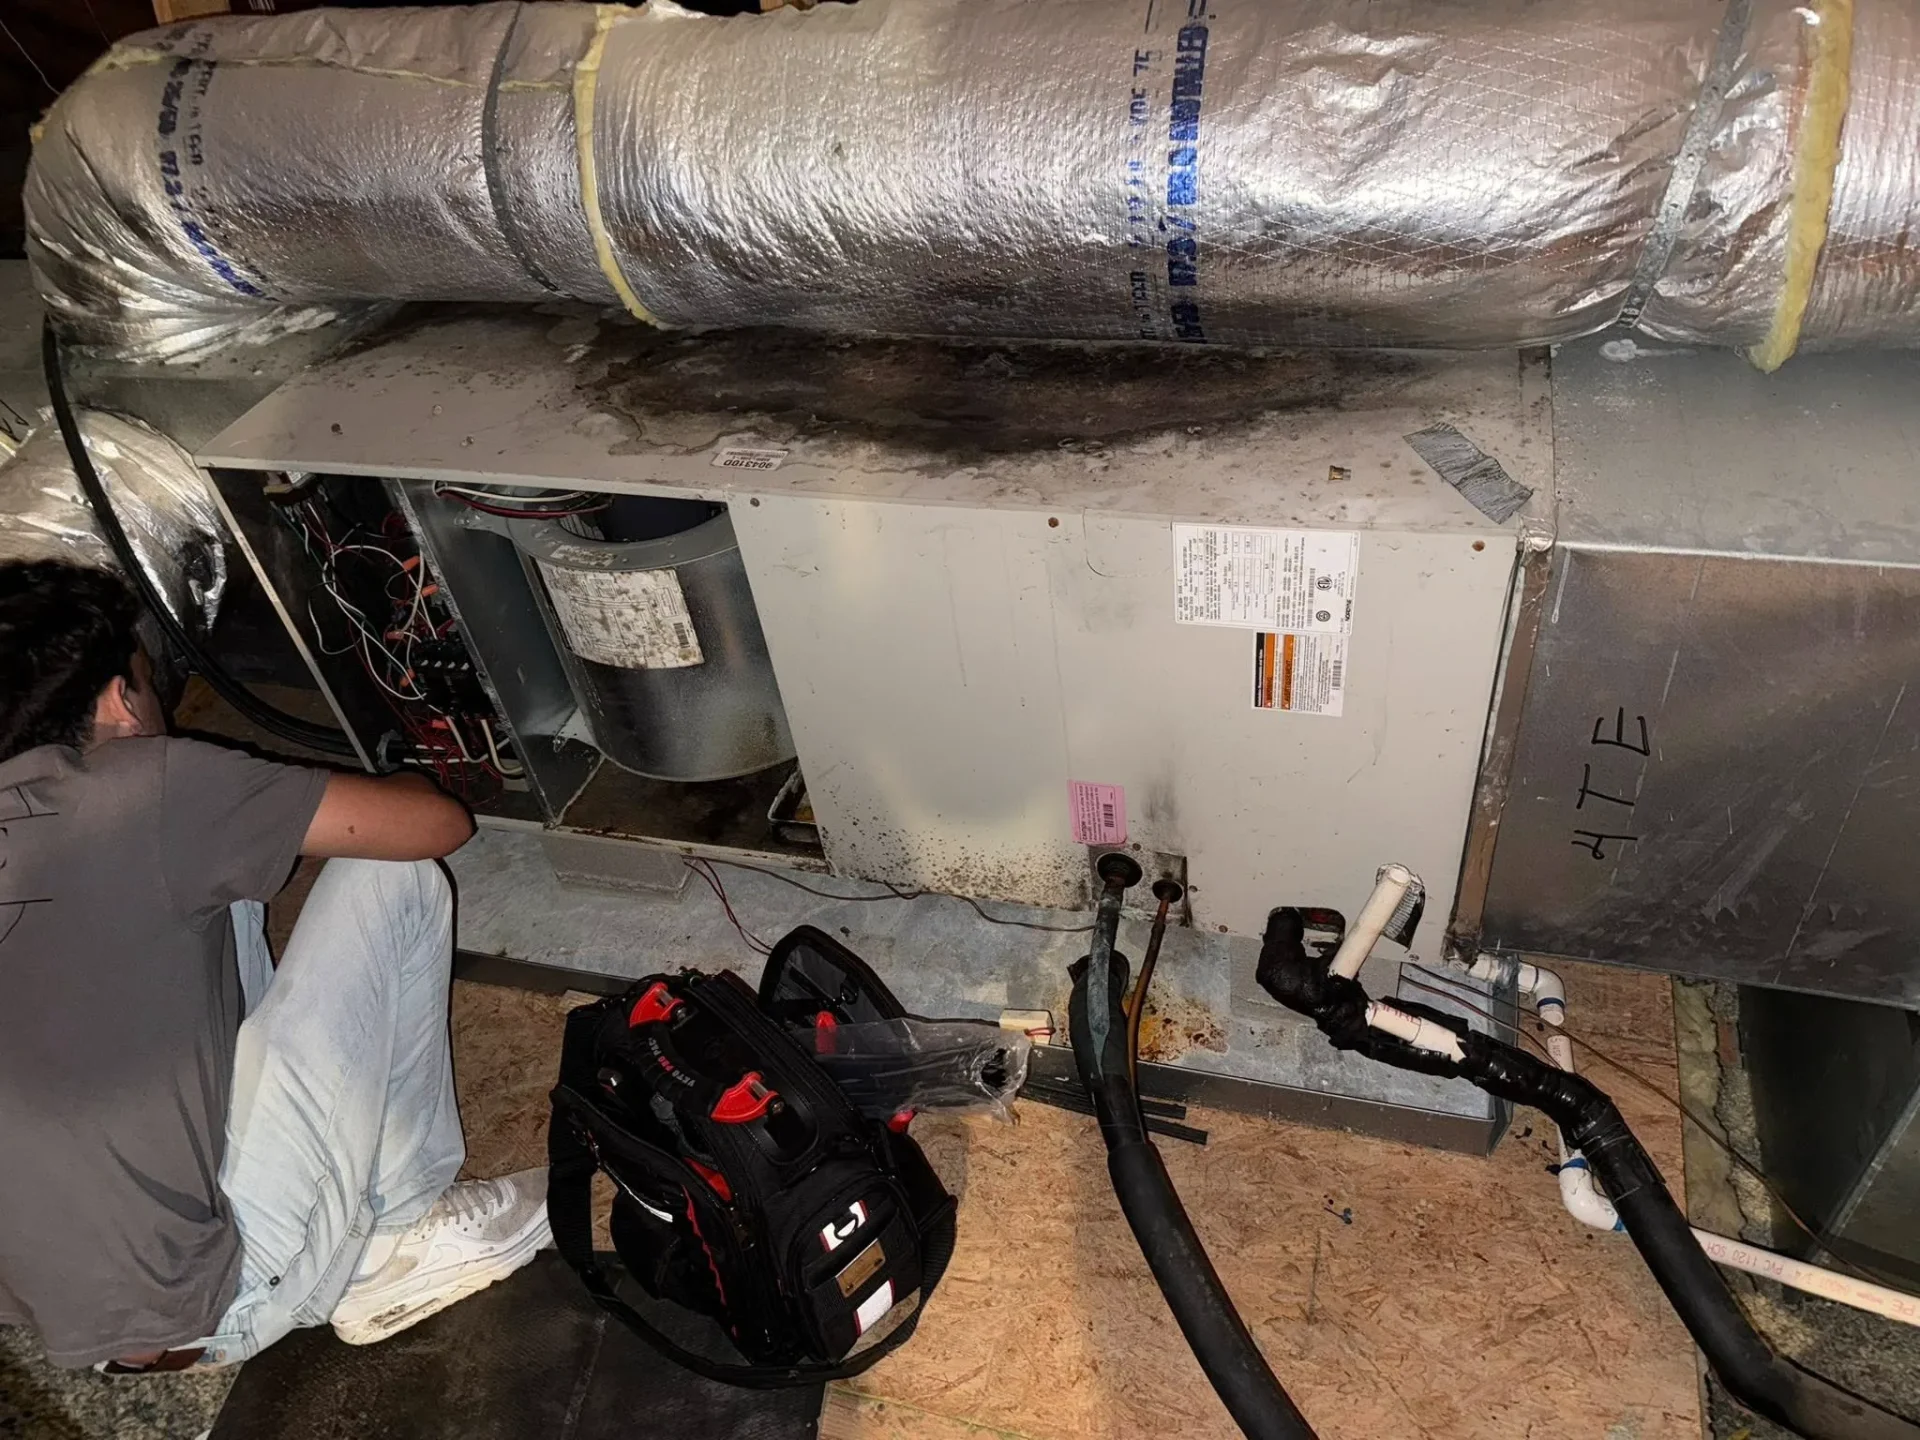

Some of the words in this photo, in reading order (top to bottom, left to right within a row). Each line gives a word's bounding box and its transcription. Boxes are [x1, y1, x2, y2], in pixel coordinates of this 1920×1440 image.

[659, 1056, 674, 1071] PRO
[672, 1070, 695, 1087] VETO
[1708, 1242, 1727, 1257] SCH
[1733, 1250, 1757, 1267] 1120
[1764, 1260, 1784, 1276] PVC
